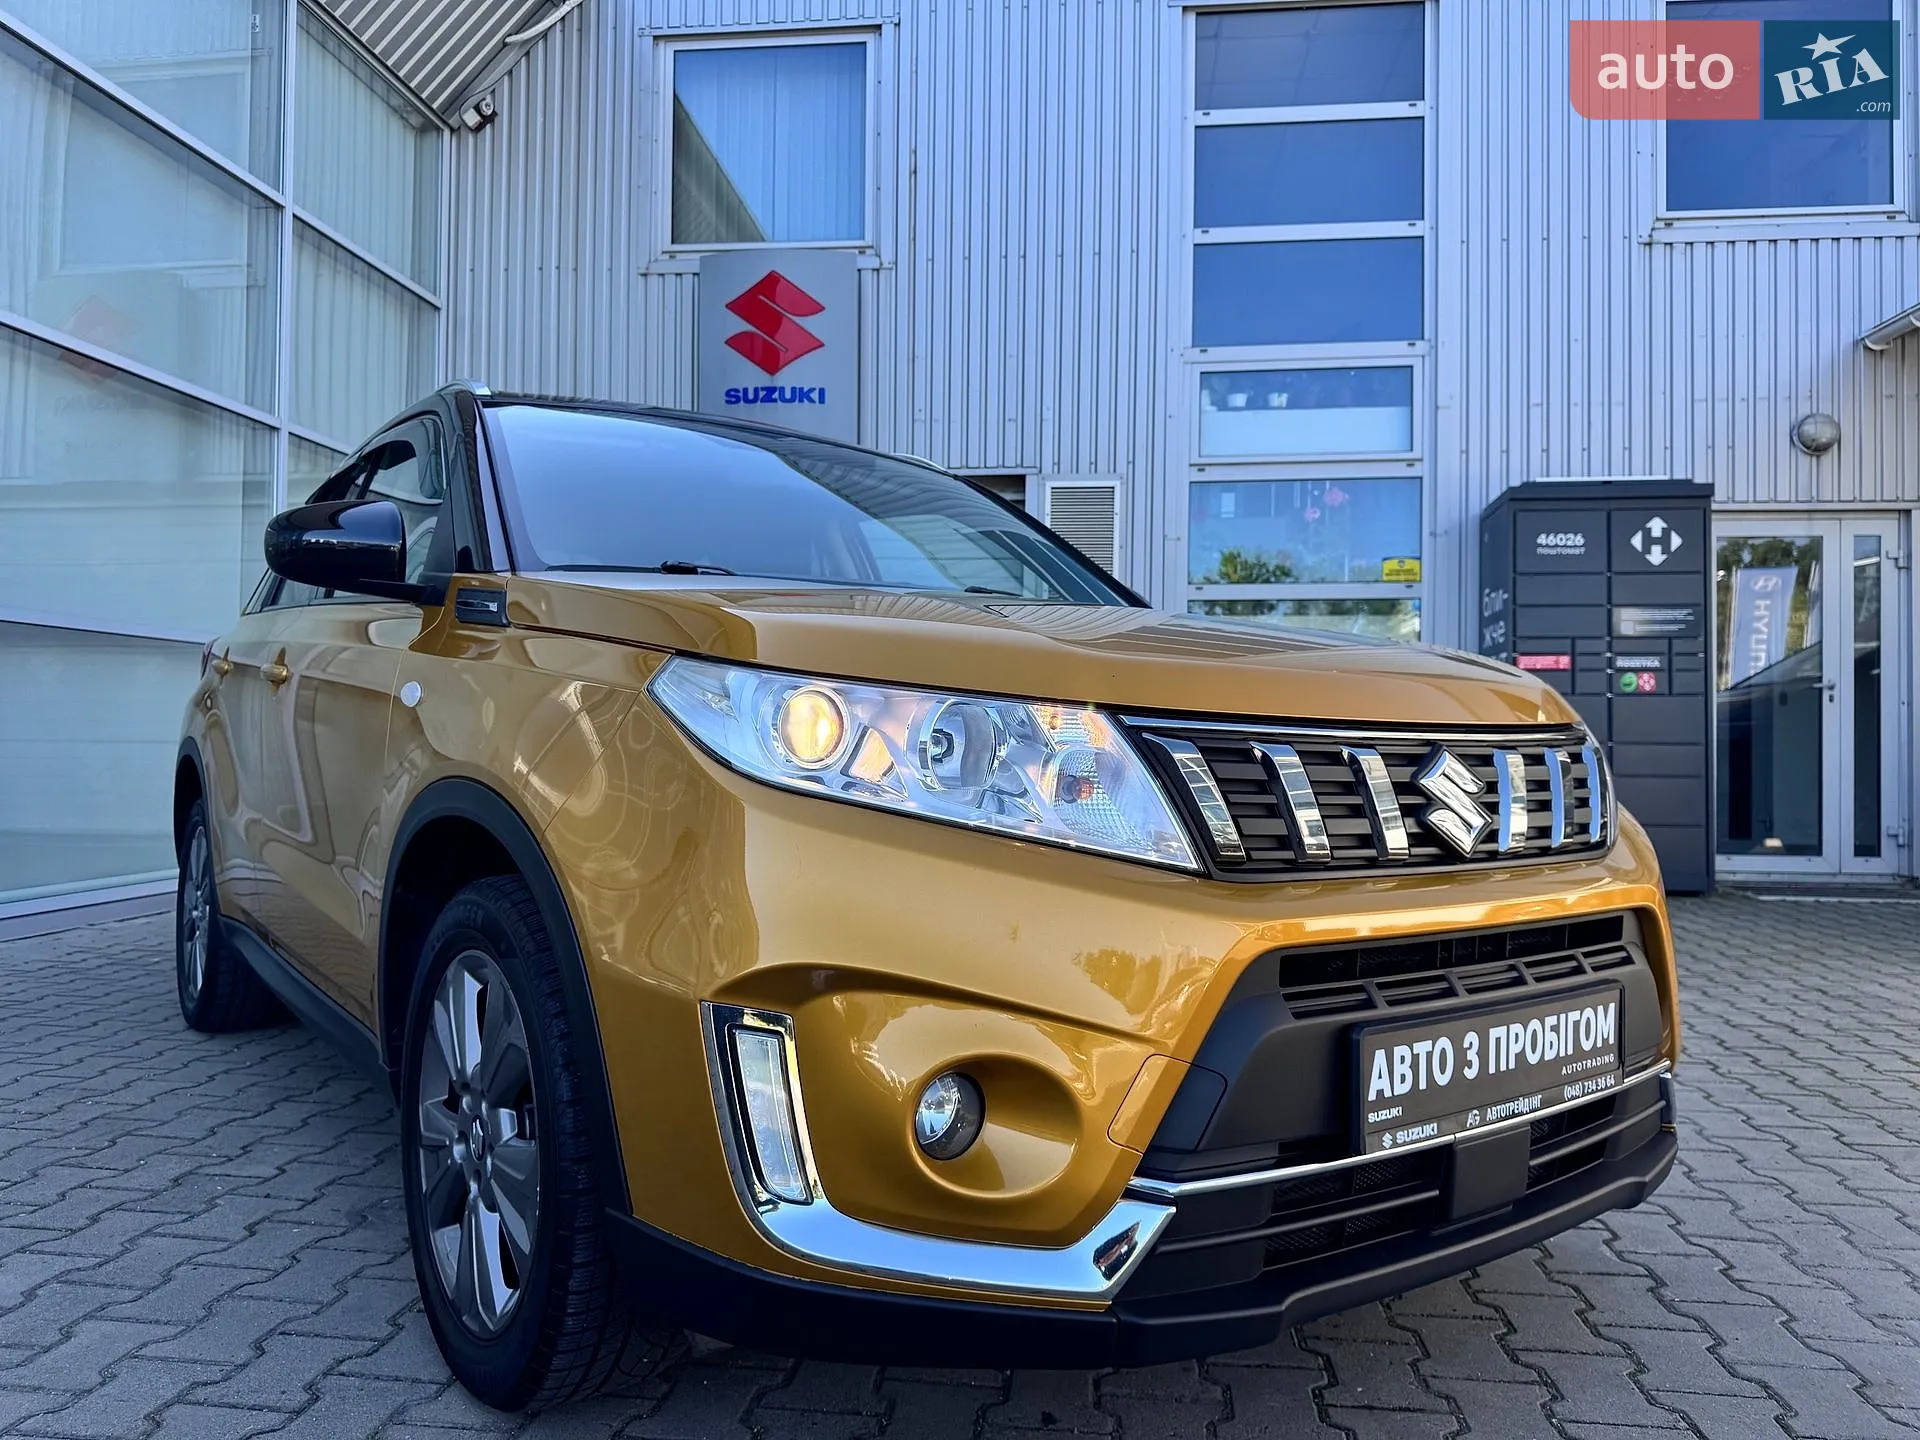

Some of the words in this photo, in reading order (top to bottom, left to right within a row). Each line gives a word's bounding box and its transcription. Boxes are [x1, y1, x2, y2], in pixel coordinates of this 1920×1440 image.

[724, 386, 826, 405] SUZUKI
[1535, 532, 1585, 546] 46026
[1367, 1036, 1455, 1102] АВТО
[1488, 1002, 1616, 1075] ПРОБІГОМ
[1561, 1053, 1615, 1076] AUTOTRADING
[1564, 1081, 1583, 1101] (048)
[1367, 1106, 1403, 1123] SUZUKI
[1486, 1094, 1543, 1121] АВТОТРЕЙДІНГ
[1395, 1122, 1438, 1144] SUZUKI
